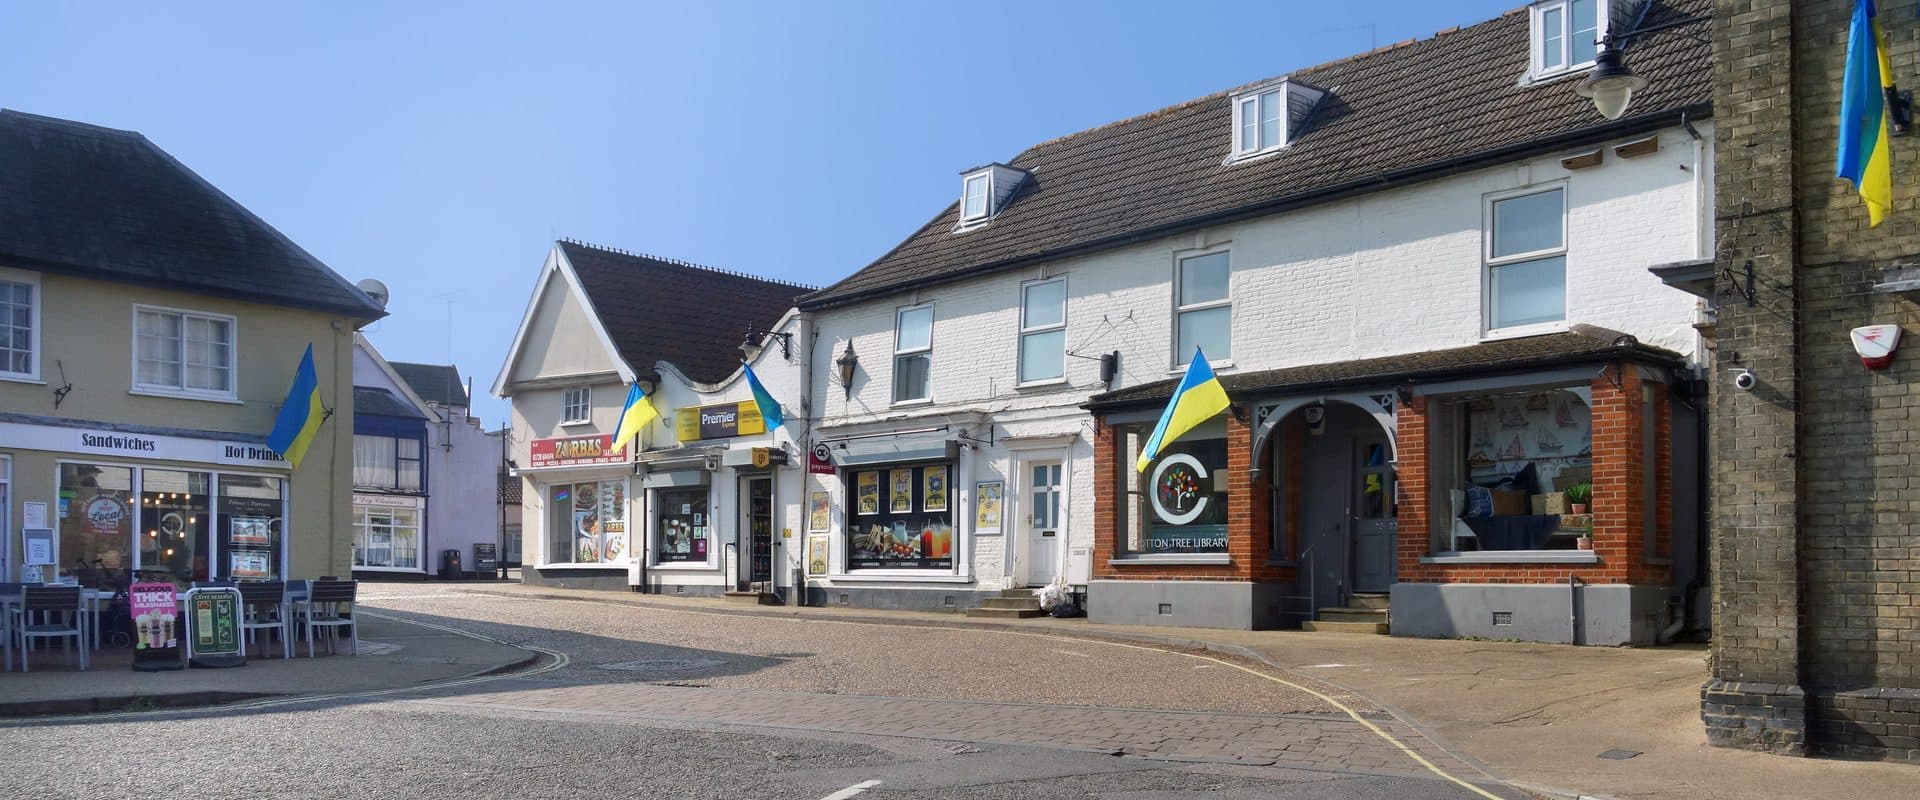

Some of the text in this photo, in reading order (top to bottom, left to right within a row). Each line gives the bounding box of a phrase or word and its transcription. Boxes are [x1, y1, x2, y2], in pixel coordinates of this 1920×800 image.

[702, 412, 735, 425] Premier
[82, 433, 155, 451] Sandwiches
[225, 445, 245, 459] Hot
[555, 439, 602, 459] ZORBAS
[91, 511, 122, 521] Local
[1171, 538, 1191, 548] TREE
[1193, 538, 1229, 548] LIBRARY
[133, 585, 172, 593] DELICIOUS
[133, 591, 172, 603] THICK
[134, 601, 175, 609] MILKSHAKES
